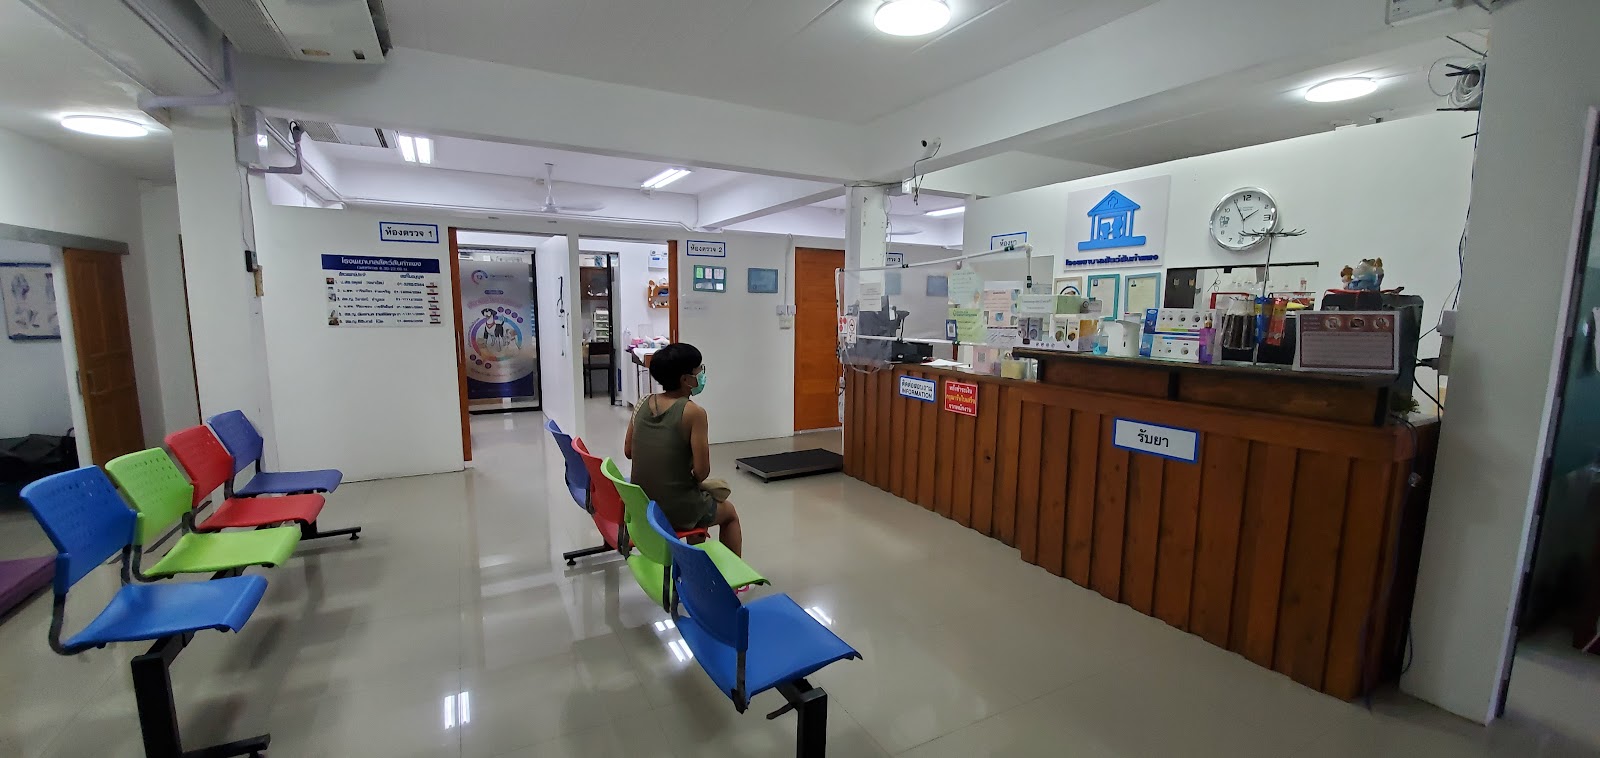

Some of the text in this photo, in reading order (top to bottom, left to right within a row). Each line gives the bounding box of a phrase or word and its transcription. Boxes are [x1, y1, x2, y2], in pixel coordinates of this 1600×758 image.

[385, 226, 424, 237] ห้องตรวจ
[690, 243, 716, 252] ห้องตรวจ
[341, 257, 422, 267] โรงพยาบาลสัตว์สันกำแพง
[1065, 253, 1159, 266] โรงพยาบาลสัตว์สันกำแพง
[901, 388, 933, 399] INFORMATION
[1137, 428, 1169, 448] รับยา
